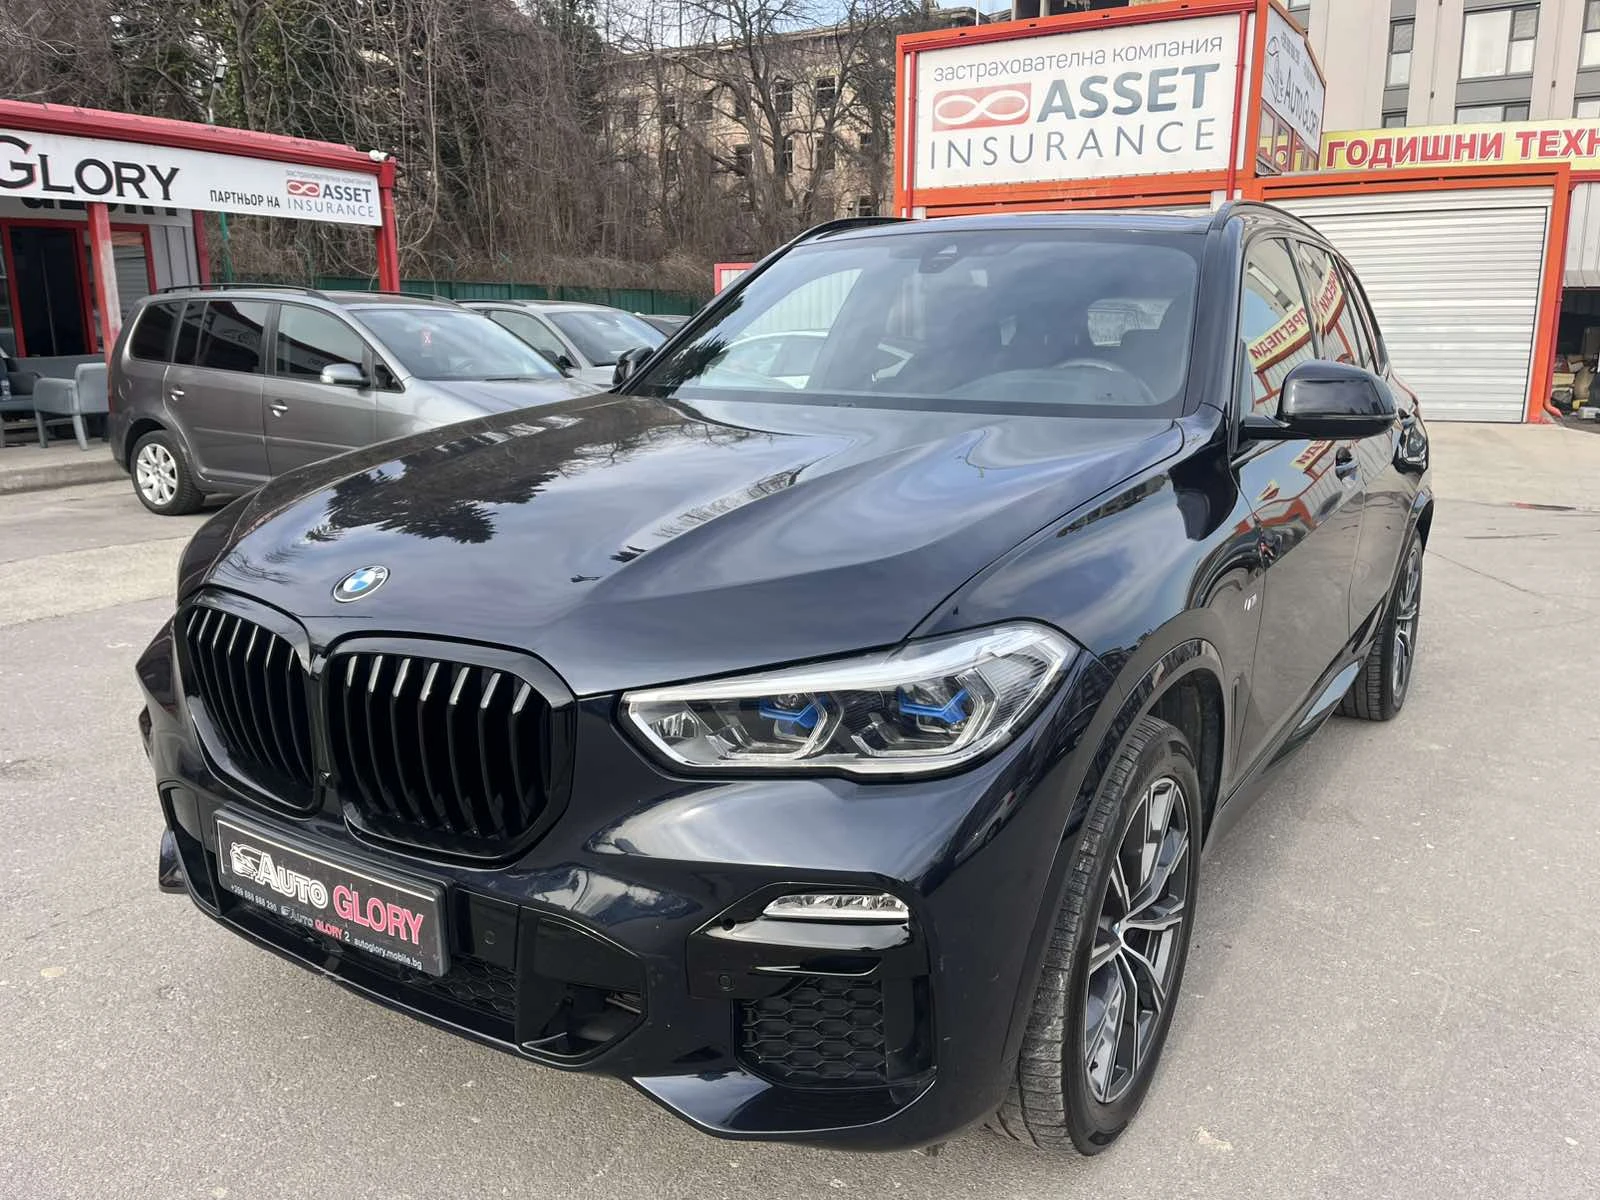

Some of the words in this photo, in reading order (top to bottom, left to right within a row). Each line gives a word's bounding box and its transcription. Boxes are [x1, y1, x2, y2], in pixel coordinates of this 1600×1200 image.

[934, 48, 1105, 83] застрахователна
[1112, 36, 1222, 64] компания
[1037, 63, 1220, 123] ASSET
[0, 134, 180, 200] GLORY
[930, 117, 1215, 170] INSURANCE
[1327, 131, 1504, 168] ГОДИШНИ
[210, 189, 264, 206] ПАРТНЬОР
[267, 195, 280, 208] НА
[287, 198, 375, 218] INSURANCE
[323, 184, 372, 203] ASSET
[255, 851, 329, 909] AUTO
[333, 884, 424, 945] GLORY
[314, 919, 343, 940] GLORY
[344, 931, 350, 942] 2
[354, 938, 422, 971] autoglory.mobile.bg
